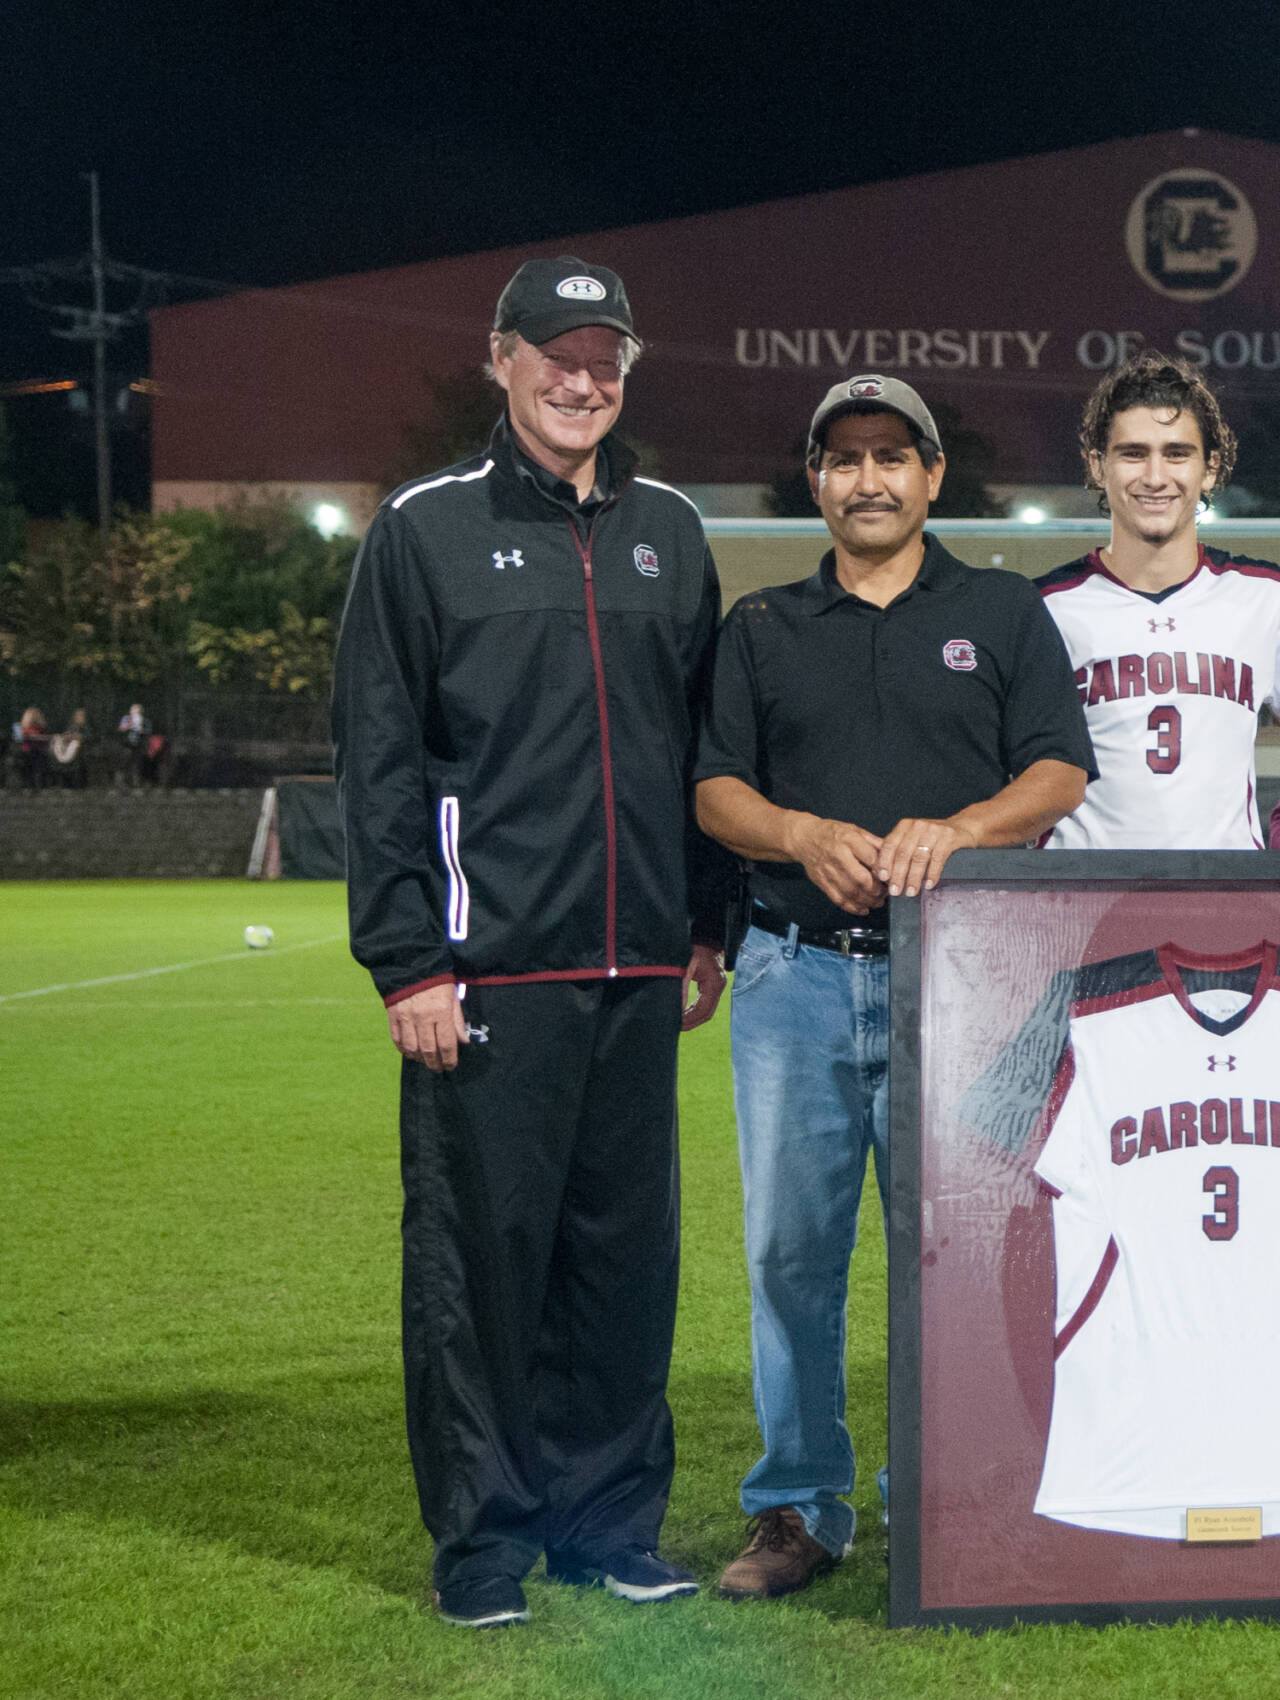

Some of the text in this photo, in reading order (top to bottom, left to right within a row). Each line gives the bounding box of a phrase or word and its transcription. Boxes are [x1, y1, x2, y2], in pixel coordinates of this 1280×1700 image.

[735, 328, 1051, 368] UNIVERSITY
[1076, 330, 1145, 369] OF
[1146, 705, 1182, 775] 3
[1202, 1165, 1240, 1242] 3
